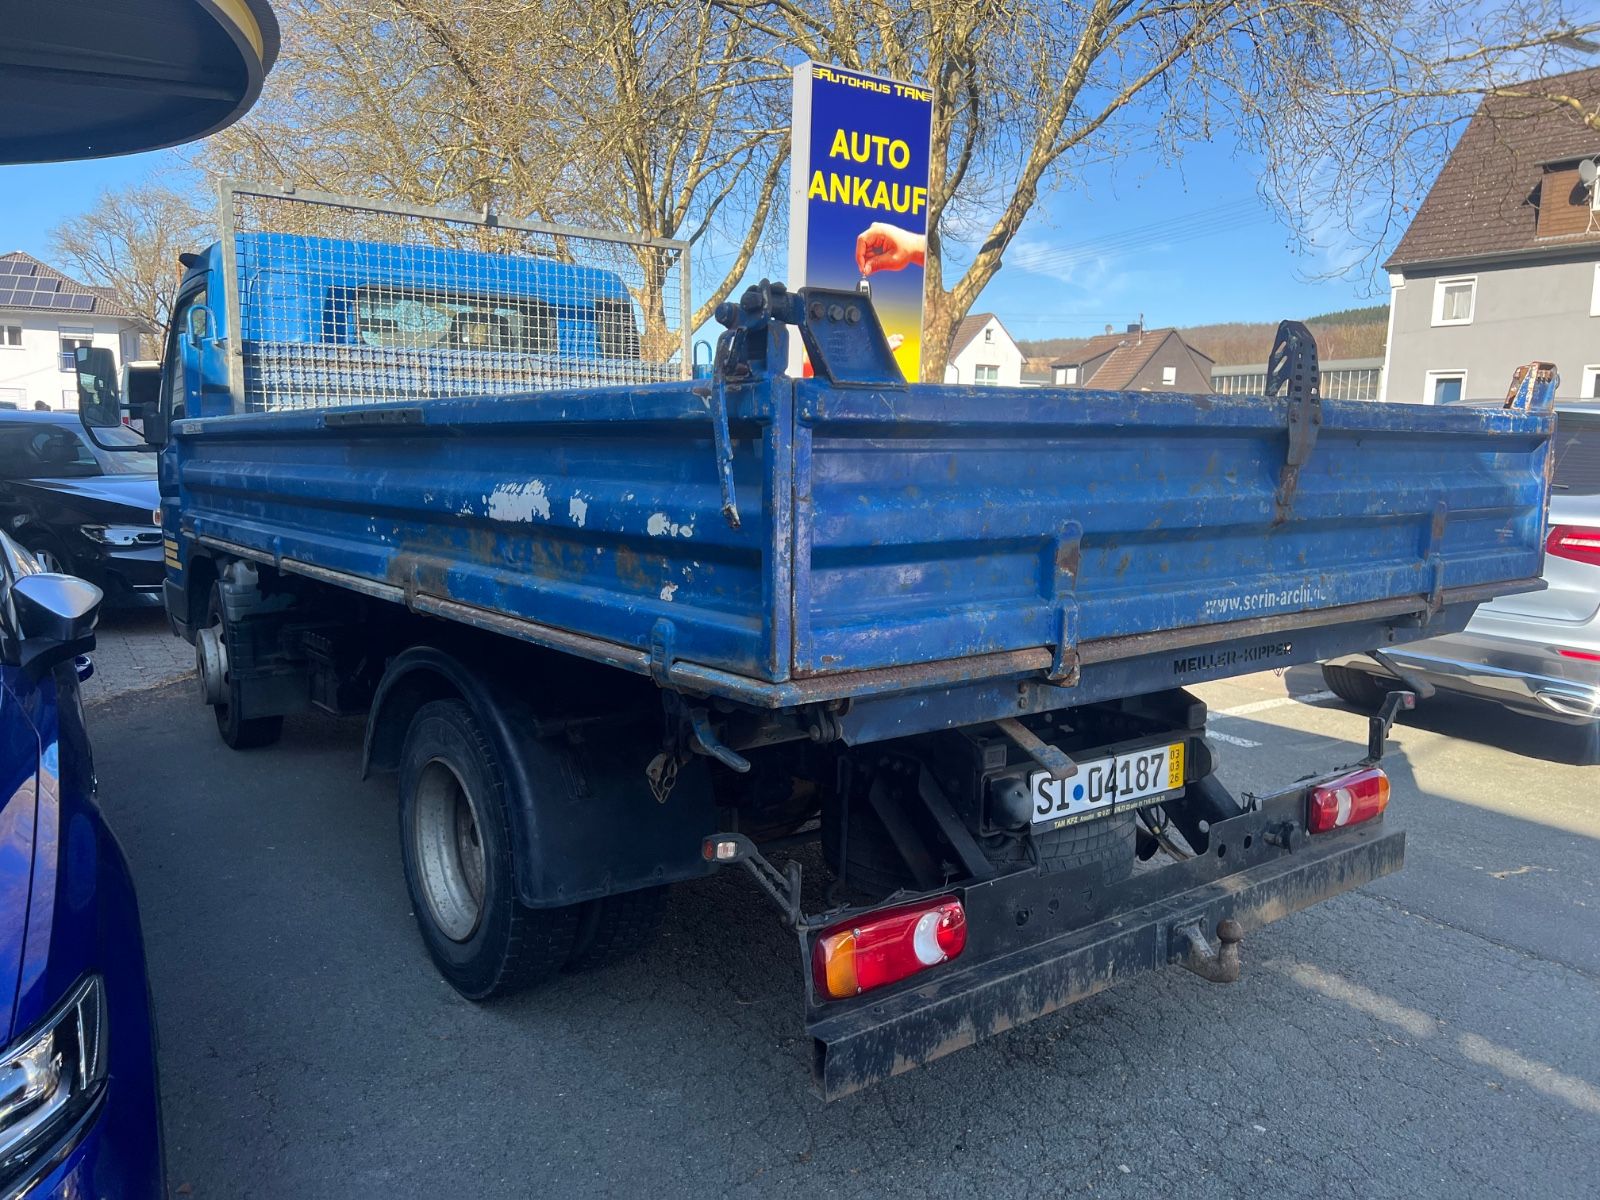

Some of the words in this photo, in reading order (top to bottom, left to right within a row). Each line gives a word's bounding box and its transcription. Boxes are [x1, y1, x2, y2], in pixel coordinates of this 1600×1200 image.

[829, 128, 911, 170] AUTO
[808, 170, 928, 215] ANKAUF
[1173, 641, 1293, 675] MEILLER-KIPPER
[1170, 748, 1180, 760] 03
[1037, 776, 1070, 815] SI
[1088, 753, 1165, 803] 04187
[1170, 772, 1180, 784] 26
